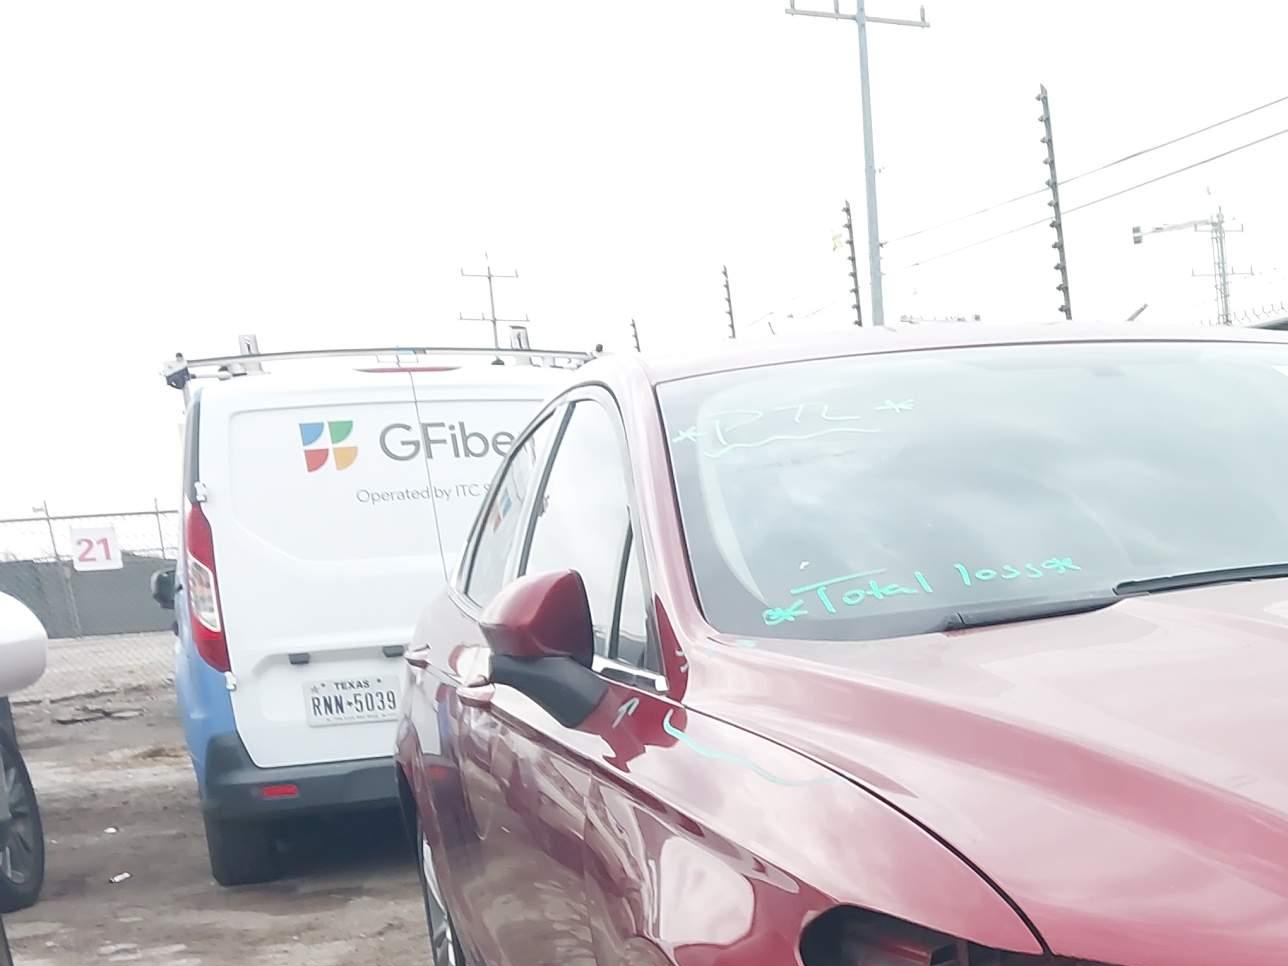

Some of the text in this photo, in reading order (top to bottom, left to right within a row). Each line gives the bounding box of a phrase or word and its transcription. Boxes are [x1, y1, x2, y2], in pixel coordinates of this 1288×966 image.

[379, 421, 516, 461] GFibe
[356, 486, 431, 504] Operated
[434, 485, 452, 501] by
[455, 484, 480, 497] ITC
[77, 537, 112, 562] 21
[790, 568, 933, 613] Total
[334, 680, 370, 690] TEXAS
